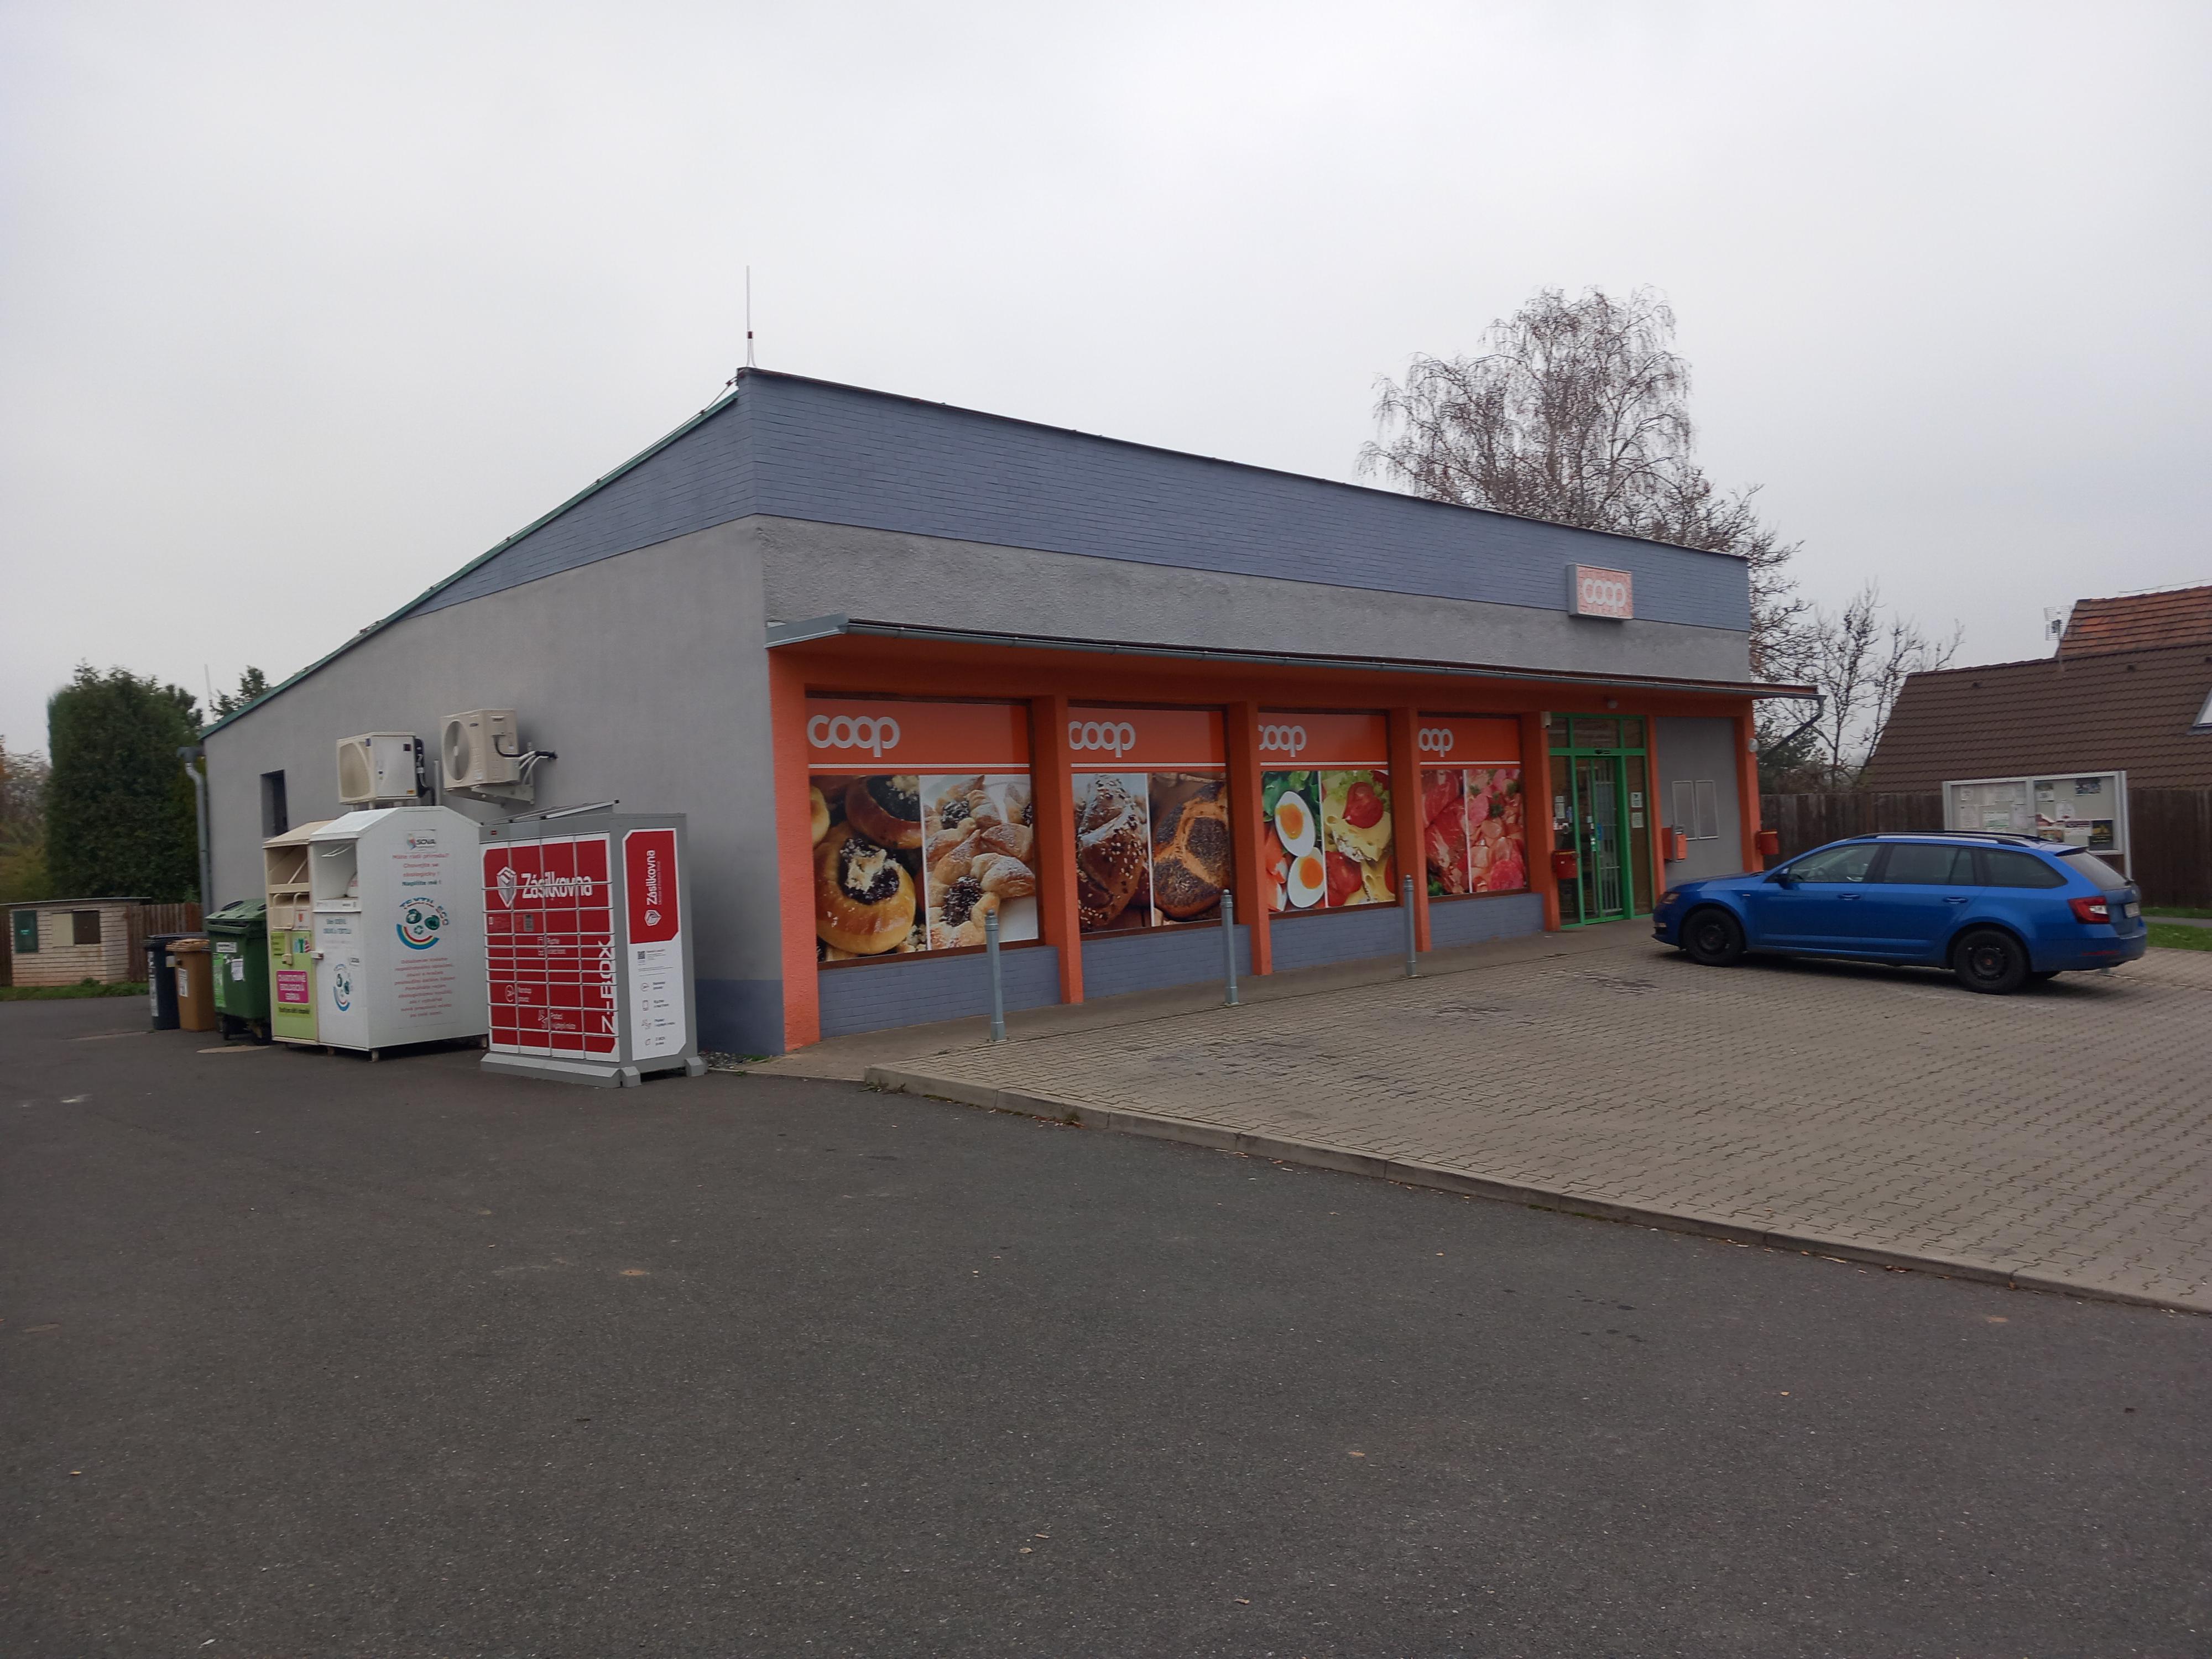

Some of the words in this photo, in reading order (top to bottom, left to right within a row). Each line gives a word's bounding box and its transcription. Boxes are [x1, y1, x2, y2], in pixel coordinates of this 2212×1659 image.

[1583, 578, 1626, 613] coop
[807, 714, 900, 758] coop
[1068, 721, 1135, 758] coop
[521, 871, 593, 899] Zásilkovna
[645, 850, 658, 905] Zásilkovna
[598, 936, 615, 1034] Z-BOX
